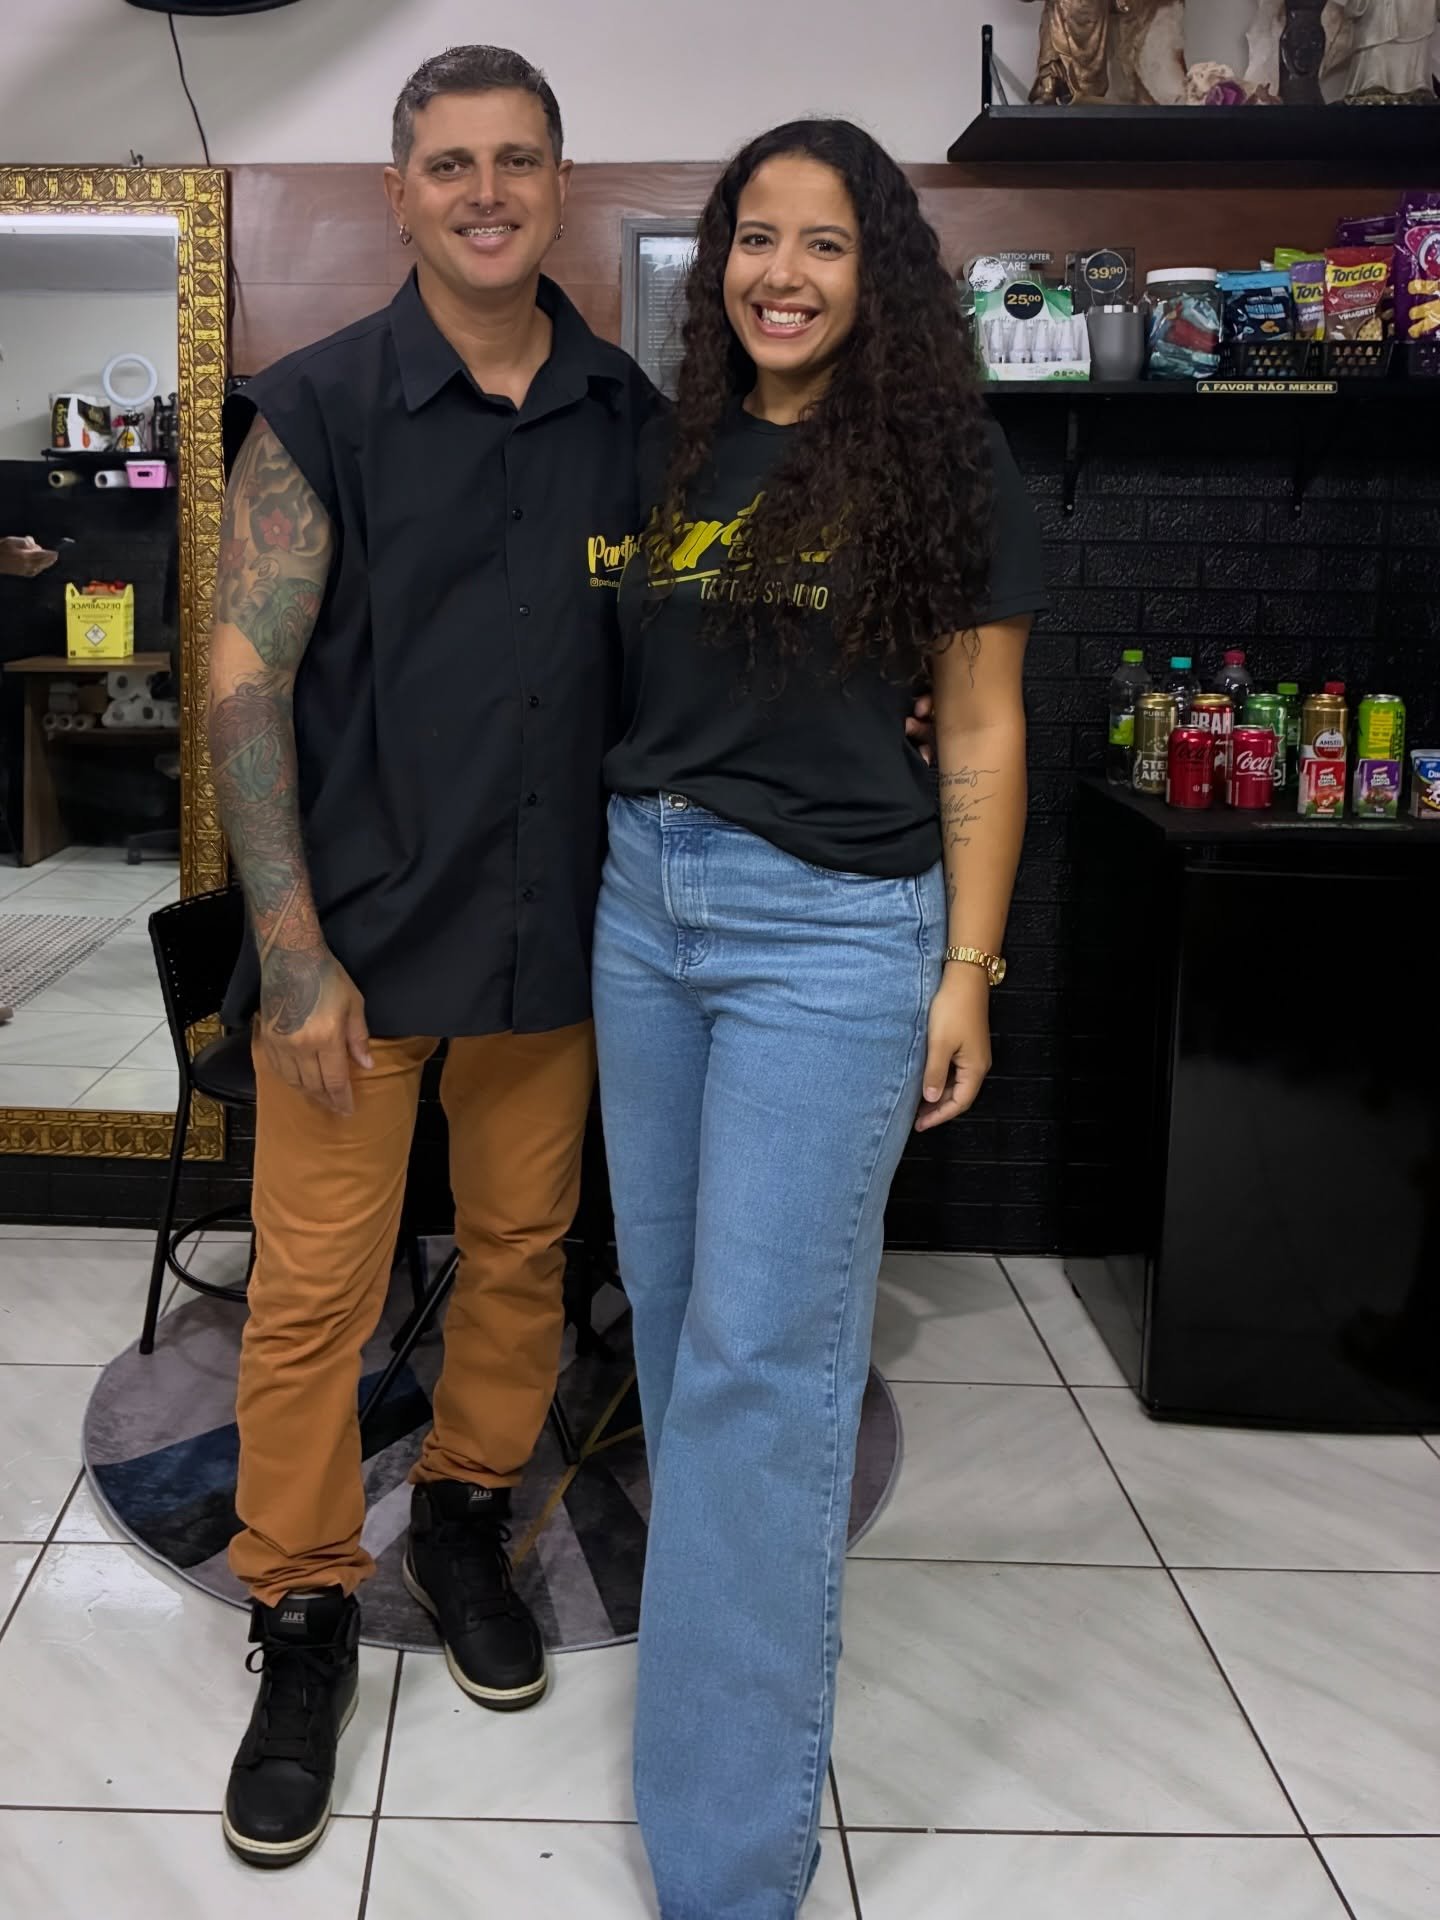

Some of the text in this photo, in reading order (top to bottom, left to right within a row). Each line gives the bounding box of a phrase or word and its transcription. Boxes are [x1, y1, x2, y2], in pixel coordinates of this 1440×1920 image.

[1000, 252, 1050, 261] TATTOO AFTER
[1002, 261, 1027, 272] CARE
[1088, 266, 1124, 280] 39,90
[1331, 265, 1384, 284] Torcida
[1007, 294, 1042, 307] 25,00
[1213, 381, 1334, 392] FAVOR NÃO MEXER
[1141, 770, 1167, 781] ART
